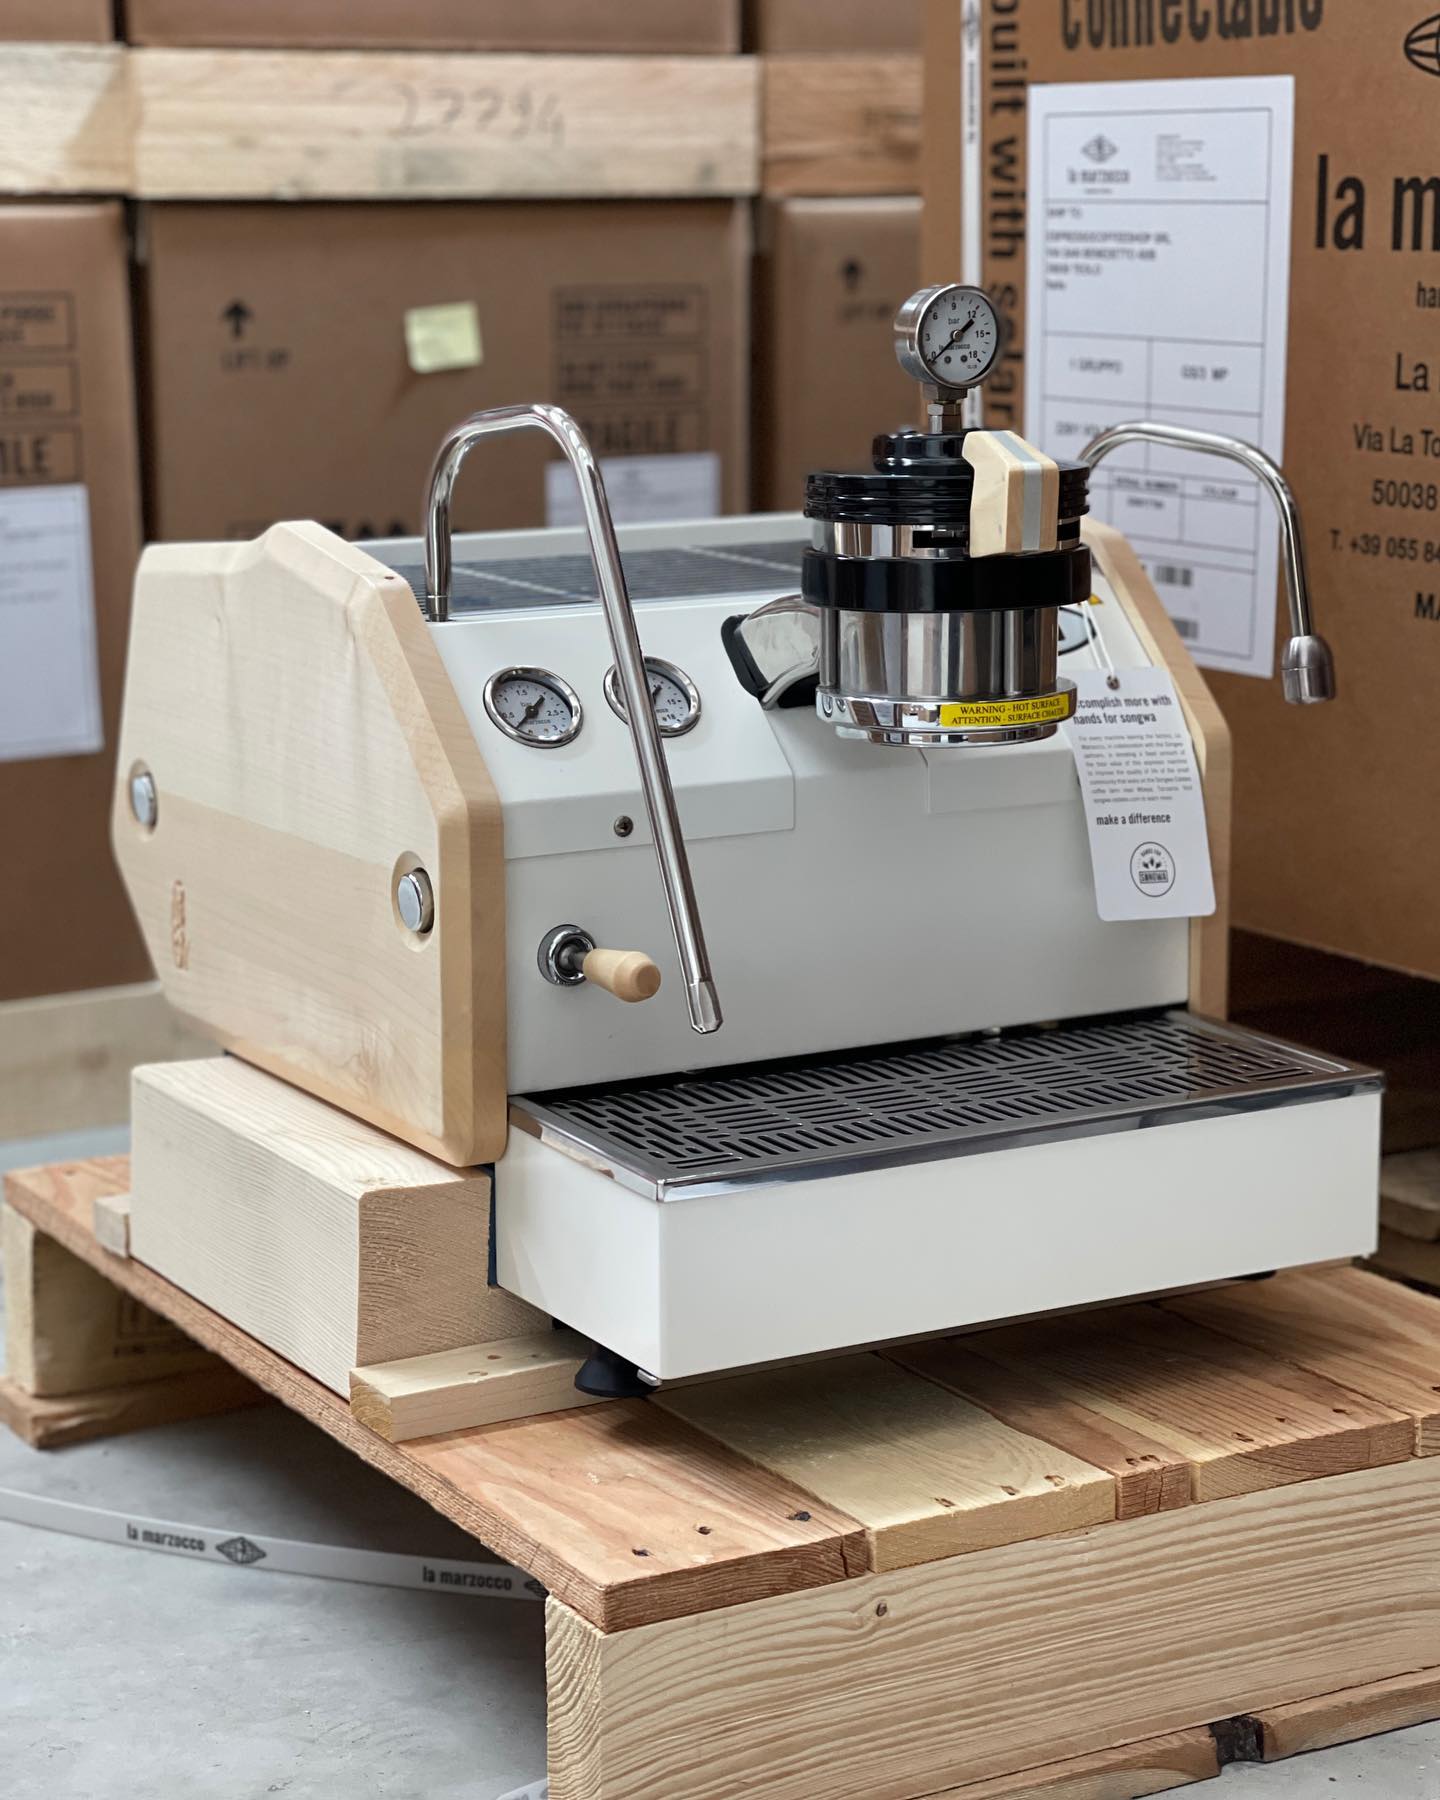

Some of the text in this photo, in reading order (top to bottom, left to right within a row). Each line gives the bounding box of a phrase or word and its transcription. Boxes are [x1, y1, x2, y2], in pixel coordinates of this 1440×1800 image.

[990, 136, 1026, 259] with
[1315, 154, 1365, 250] la
[951, 302, 956, 310] 9
[933, 312, 938, 320] 6
[976, 330, 985, 338] 15
[969, 351, 978, 359] 18
[1396, 353, 1429, 391] La
[1354, 424, 1382, 450] Via
[1391, 426, 1413, 454] La
[1372, 479, 1437, 511] 50038
[1330, 529, 1343, 551] T.
[1350, 533, 1381, 556] +39
[1386, 537, 1418, 561] 055
[960, 705, 1006, 715] WARNING
[1012, 702, 1029, 711] HOT
[1031, 698, 1060, 710] SURFACE
[1079, 695, 1172, 709] complish more with
[951, 715, 1001, 725] ATTENTION
[1007, 712, 1040, 722] SURFACE
[1104, 712, 1118, 723] for
[1120, 713, 1157, 724] songwa
[1096, 812, 1171, 825] make a difference
[127, 1523, 205, 1551] la marzocco
[423, 1566, 512, 1591] la marzocco
